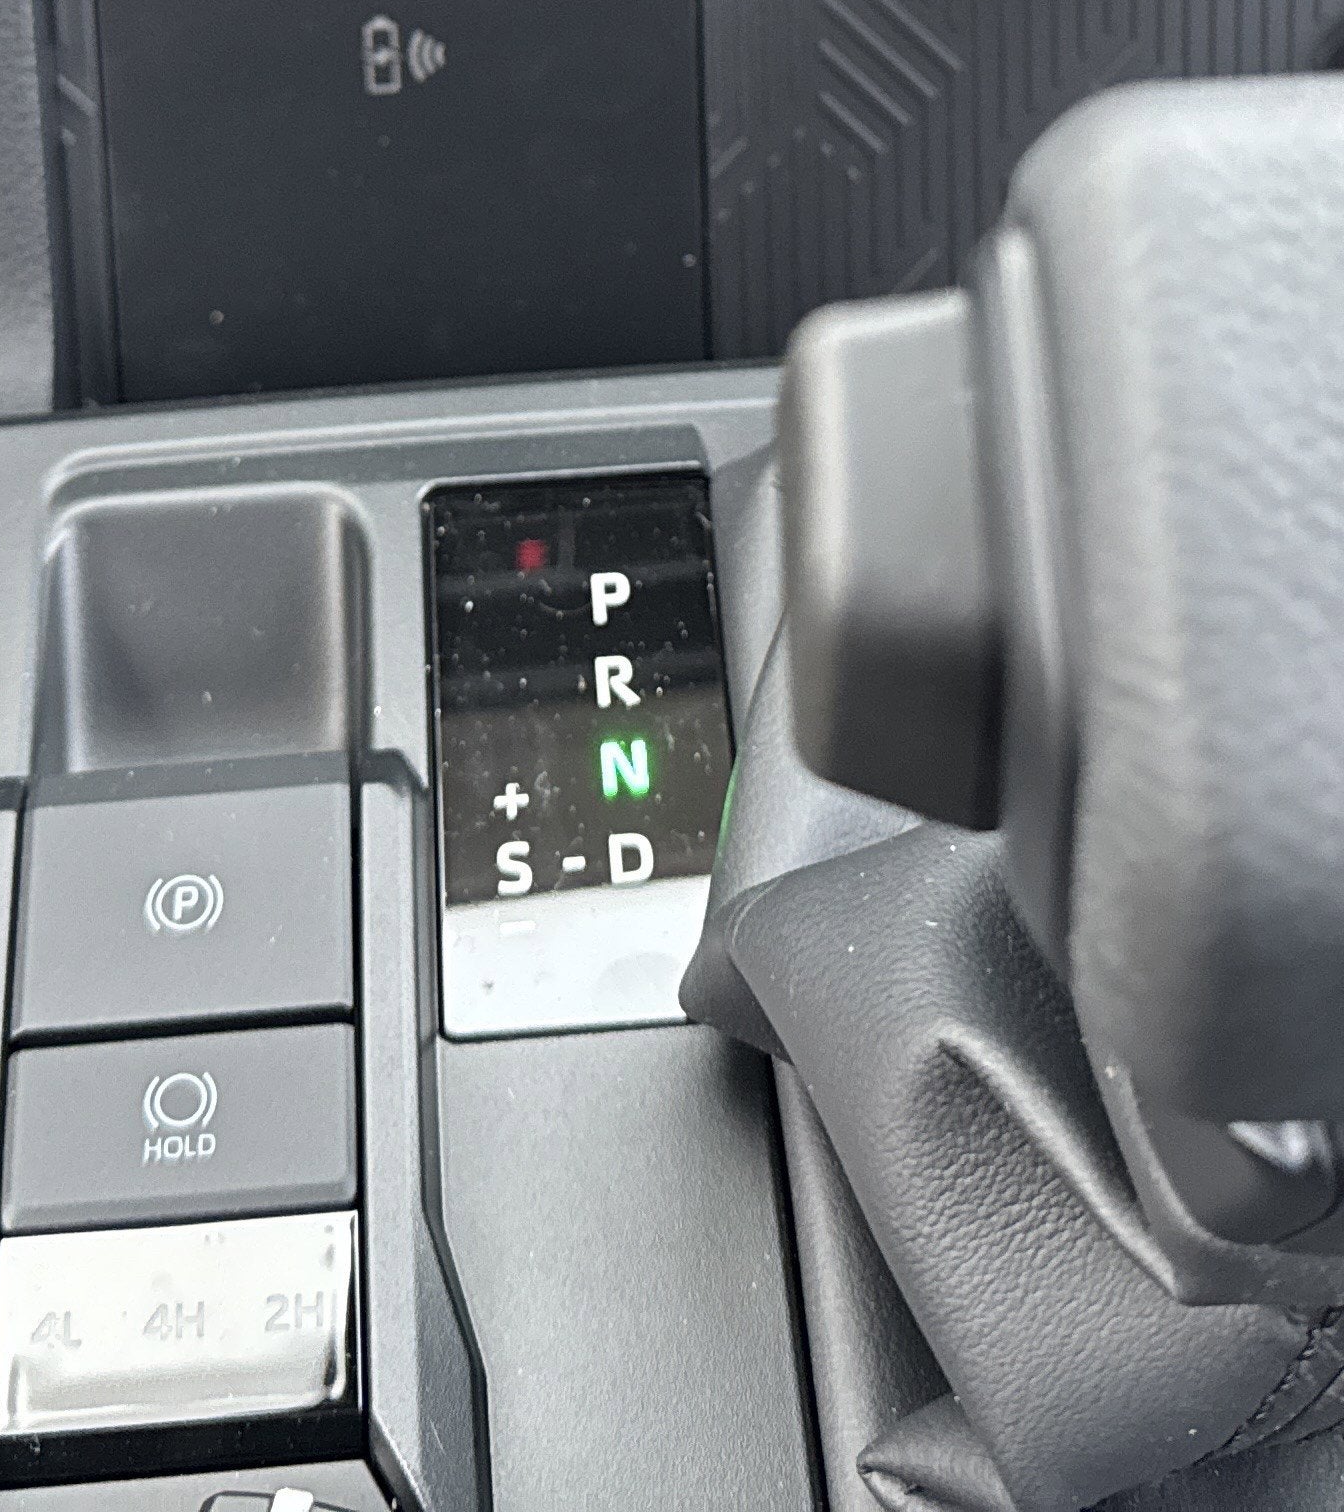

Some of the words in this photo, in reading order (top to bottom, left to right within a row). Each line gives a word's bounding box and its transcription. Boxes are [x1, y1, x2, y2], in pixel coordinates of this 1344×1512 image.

[589, 571, 631, 626] P
[594, 654, 641, 708] R
[599, 739, 650, 797] N
[496, 840, 534, 896] S
[608, 832, 655, 885] D
[143, 1133, 217, 1165] HOLD
[30, 1310, 83, 1349] 4L
[142, 1300, 205, 1341] 4H
[264, 1290, 324, 1332] 2H
